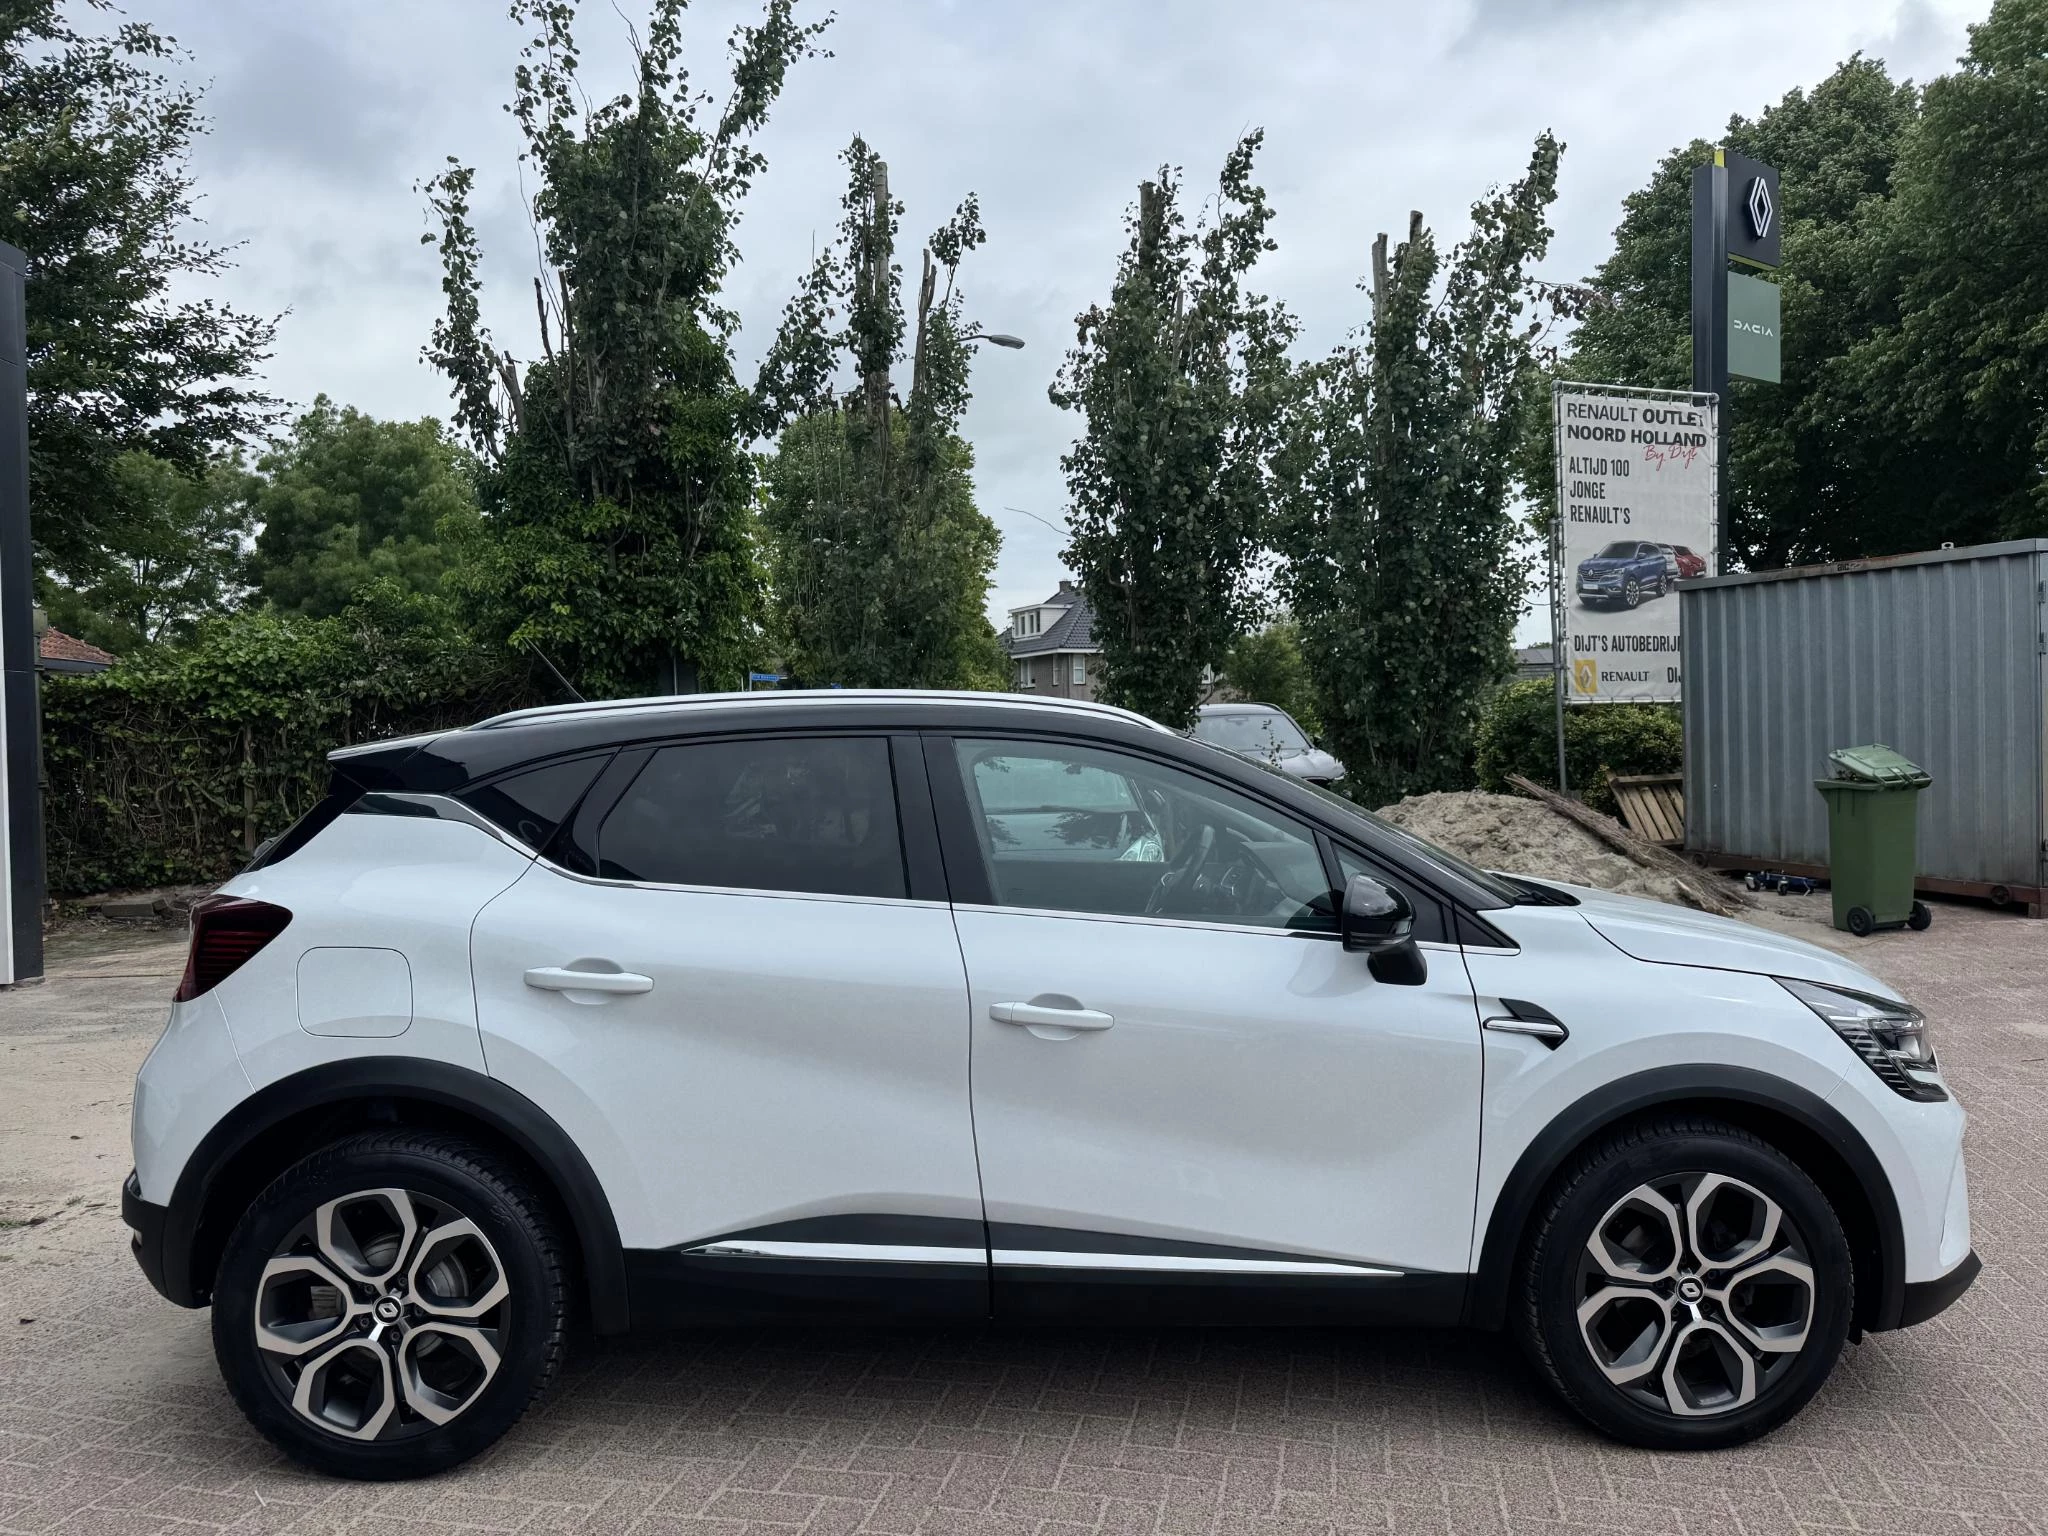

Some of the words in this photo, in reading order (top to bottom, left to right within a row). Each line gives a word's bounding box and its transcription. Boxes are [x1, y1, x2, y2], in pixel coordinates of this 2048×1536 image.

[1734, 320, 1773, 337] DACIA
[1567, 403, 1637, 422] RENAULT
[1567, 425, 1626, 442] NOORD
[1631, 430, 1707, 448] HOLLAND
[1569, 456, 1607, 476] ALTIJD
[1610, 459, 1630, 477] 100
[1643, 445, 1664, 471] By
[1570, 481, 1606, 500] JONGE
[1570, 505, 1631, 524] RENAULT'S
[1574, 635, 1608, 652] DIJT'S
[1601, 671, 1650, 682] RENAULT
[1667, 667, 1681, 683] DI
